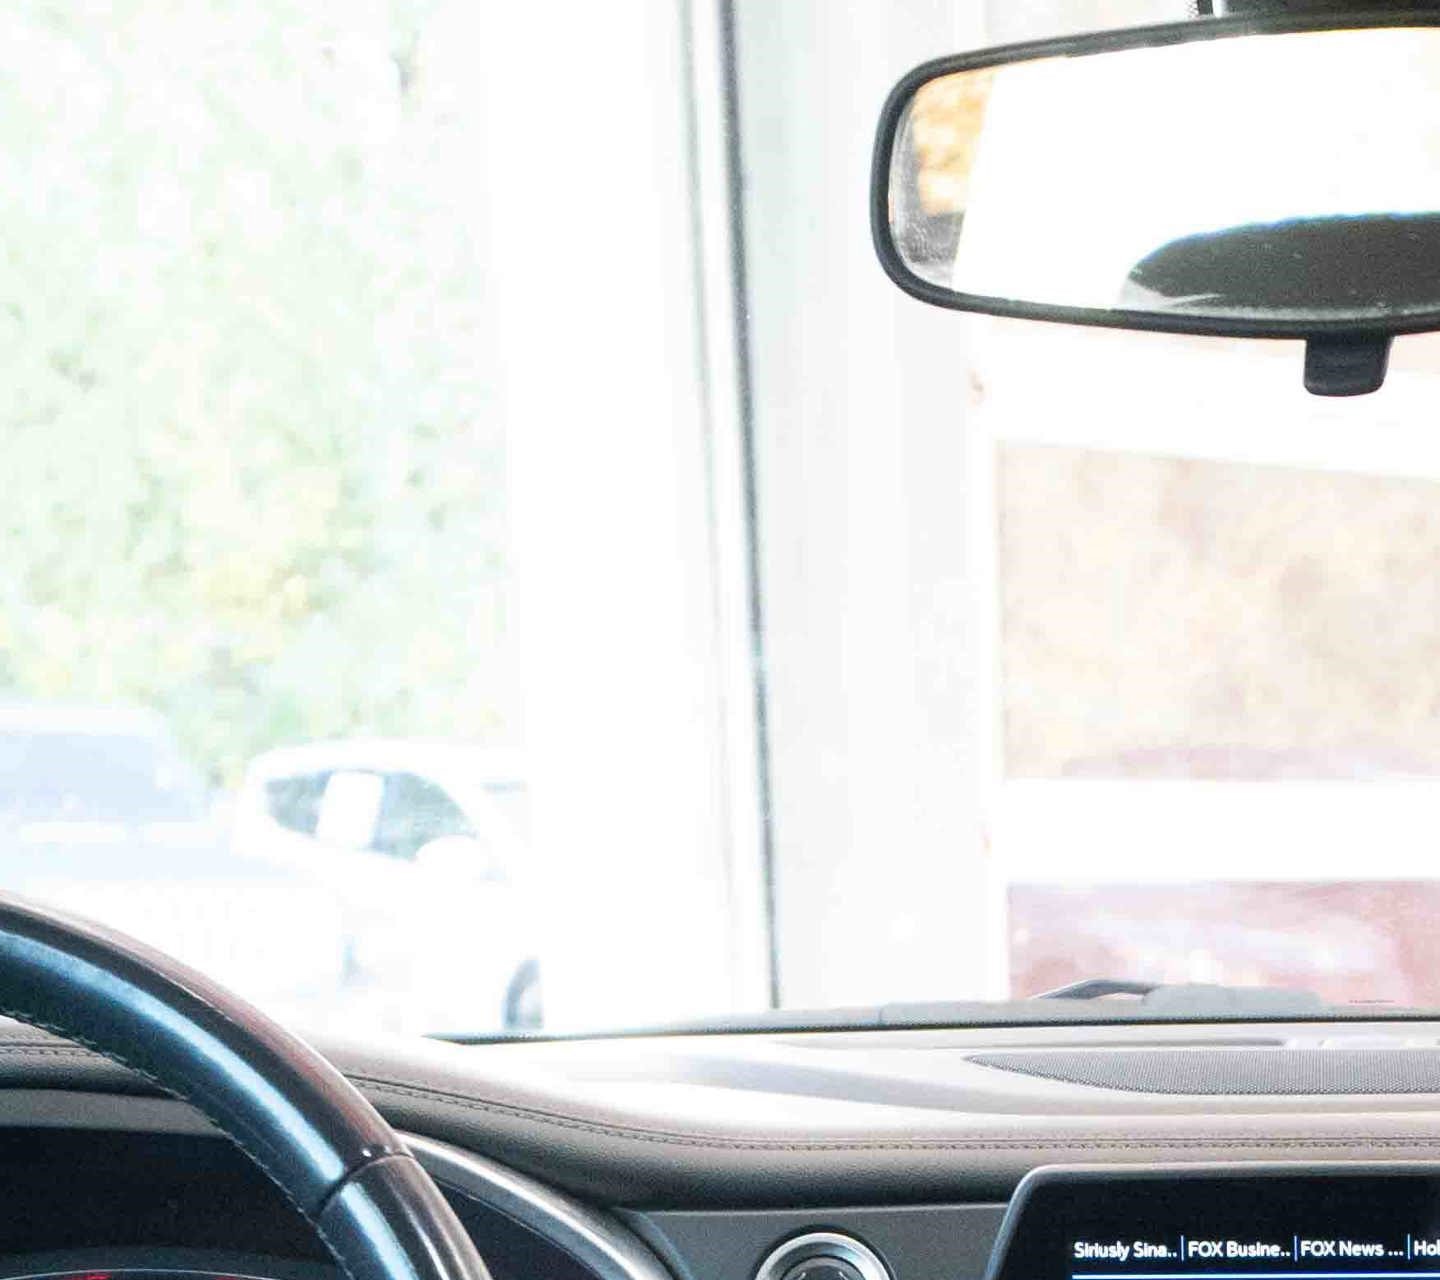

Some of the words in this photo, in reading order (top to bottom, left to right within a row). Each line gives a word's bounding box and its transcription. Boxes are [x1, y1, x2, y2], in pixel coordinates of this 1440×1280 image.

[1188, 1240, 1223, 1258] FOX
[1300, 1240, 1335, 1257] FOX
[1339, 1240, 1384, 1257] News
